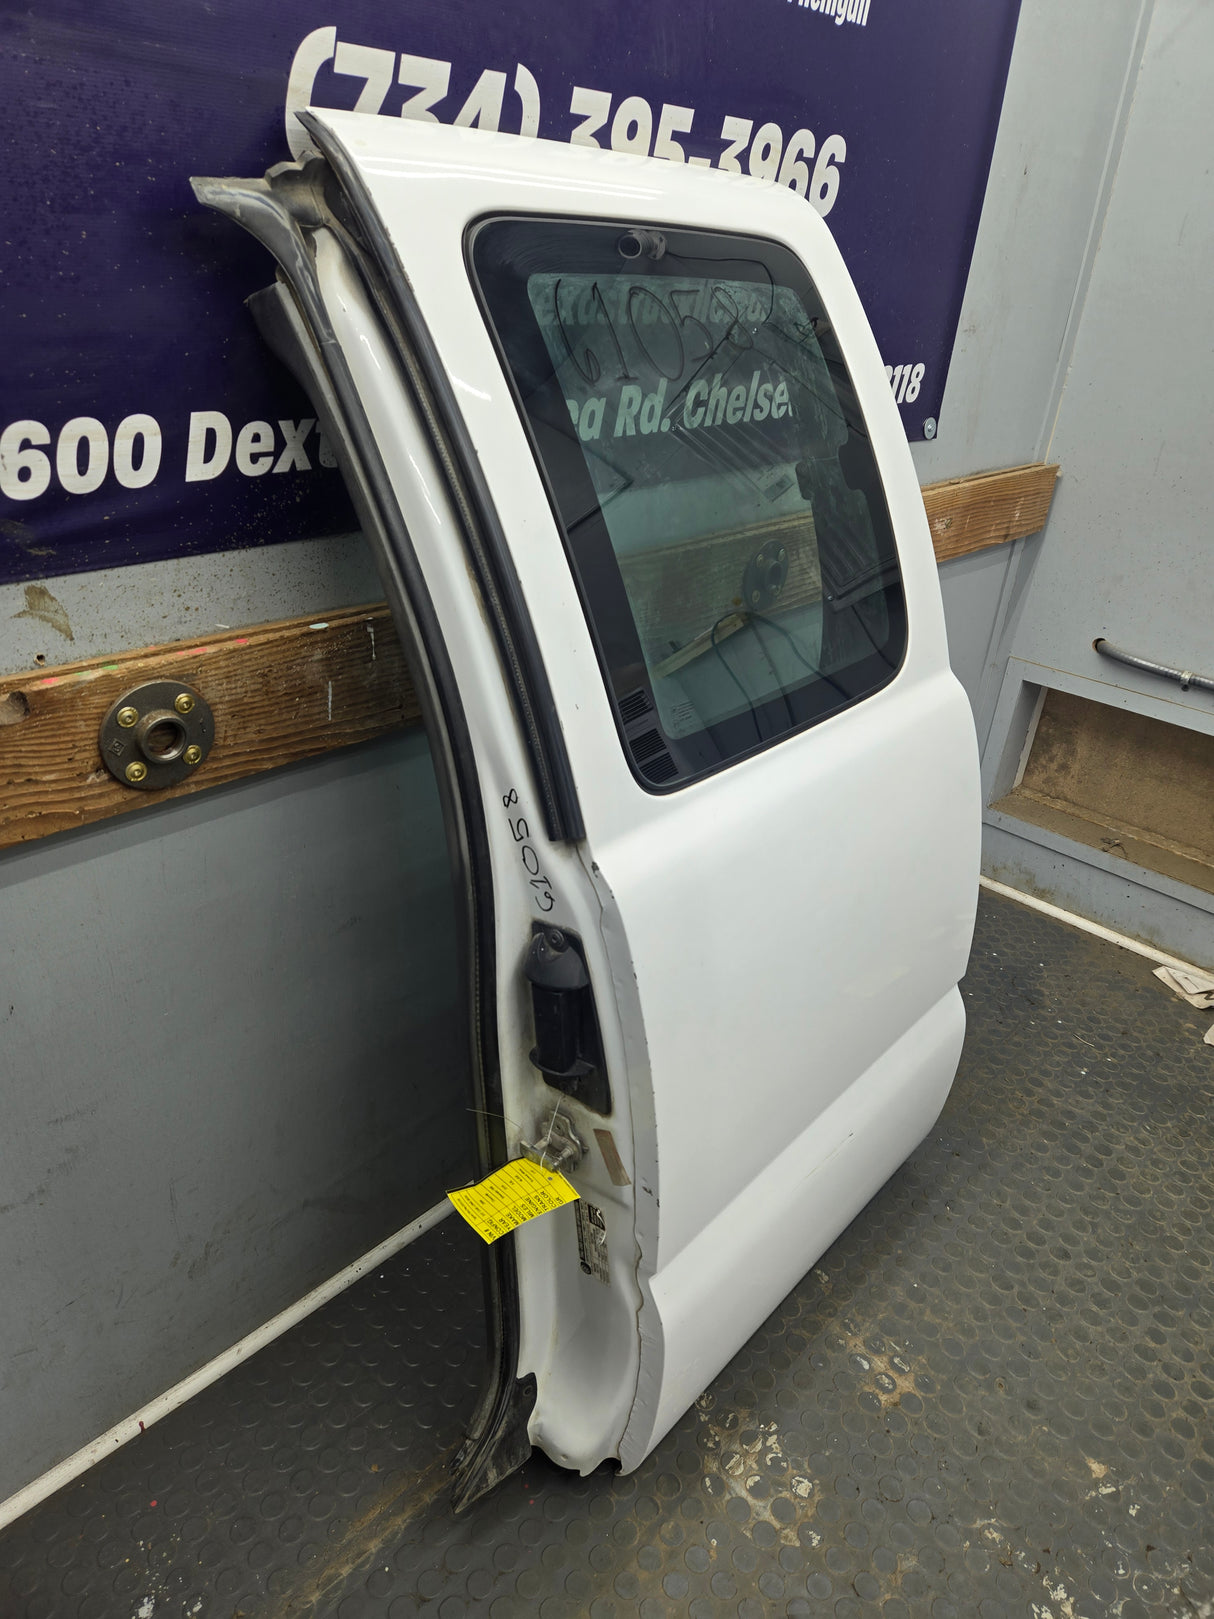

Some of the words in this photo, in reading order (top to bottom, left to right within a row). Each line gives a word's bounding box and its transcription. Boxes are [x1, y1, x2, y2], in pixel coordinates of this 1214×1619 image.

[613, 377, 671, 437] Rd.
[683, 370, 793, 429] Chelse
[0, 413, 162, 500] 600
